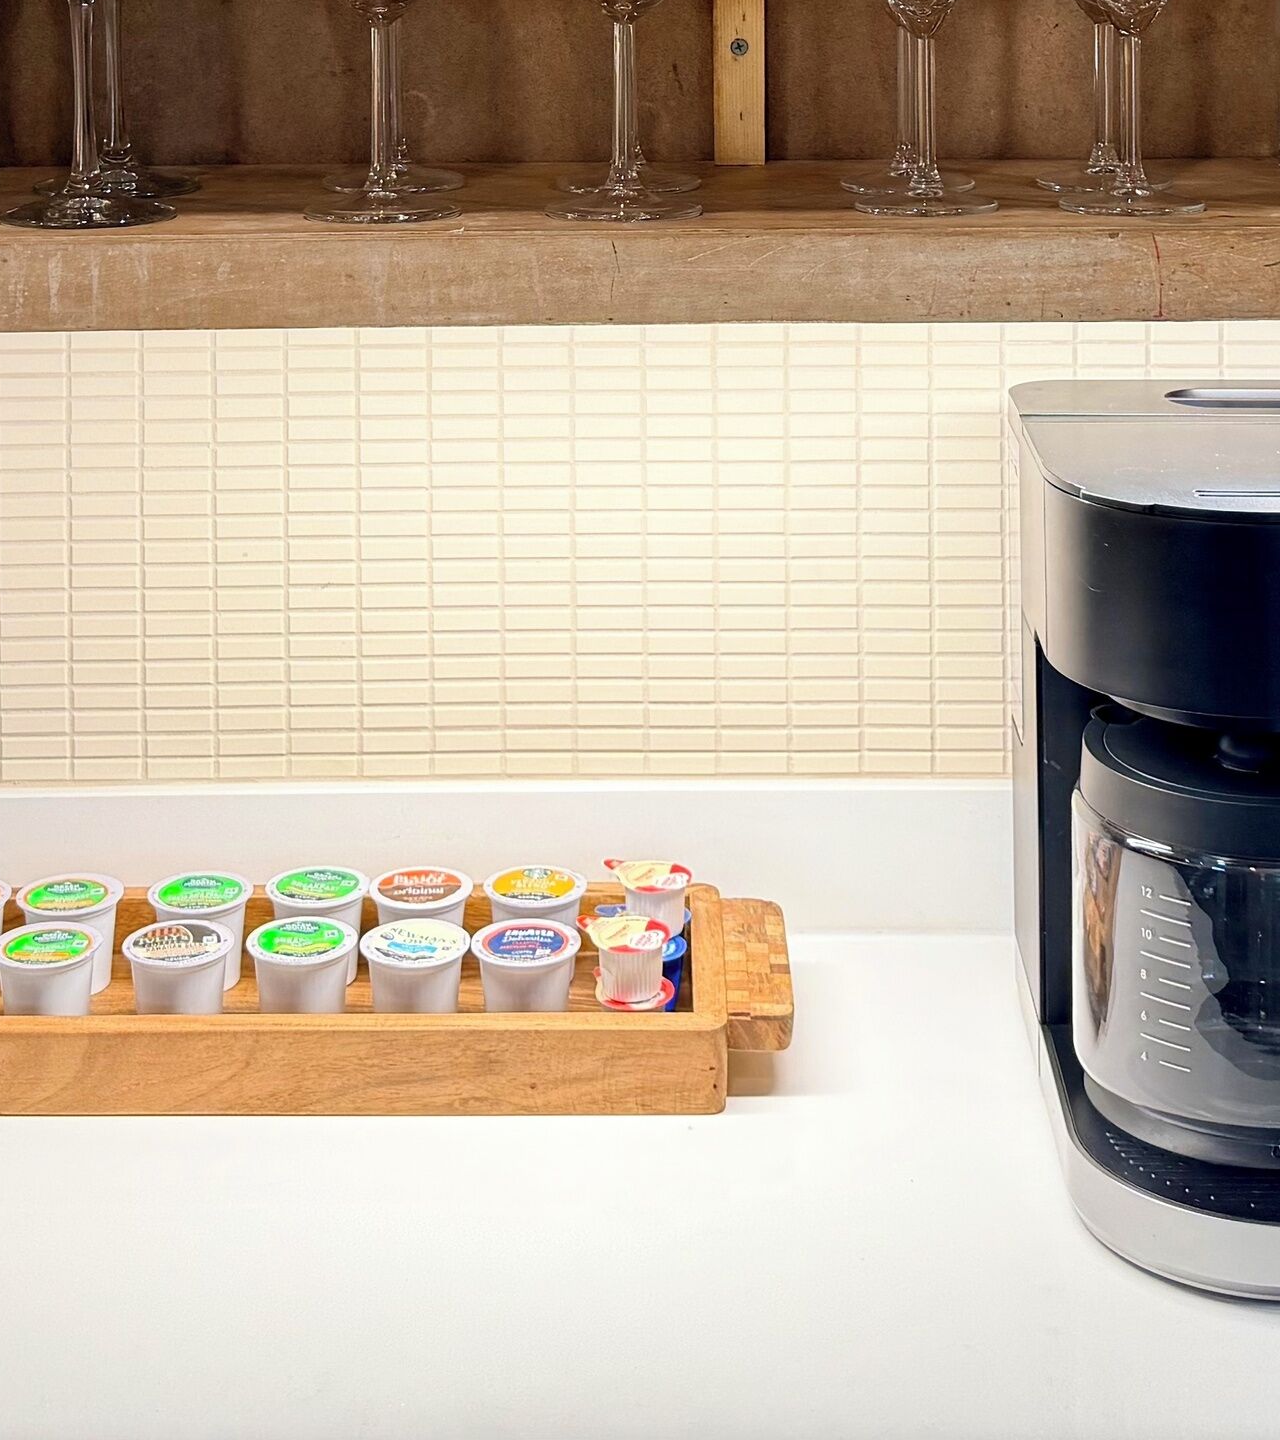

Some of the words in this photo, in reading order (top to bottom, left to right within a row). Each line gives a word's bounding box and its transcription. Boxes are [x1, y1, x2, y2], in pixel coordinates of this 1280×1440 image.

[1140, 886, 1152, 899] 12
[1140, 928, 1152, 940] 10
[1140, 969, 1147, 980] 8
[1140, 1010, 1147, 1021] 6
[1140, 1051, 1147, 1061] 4
